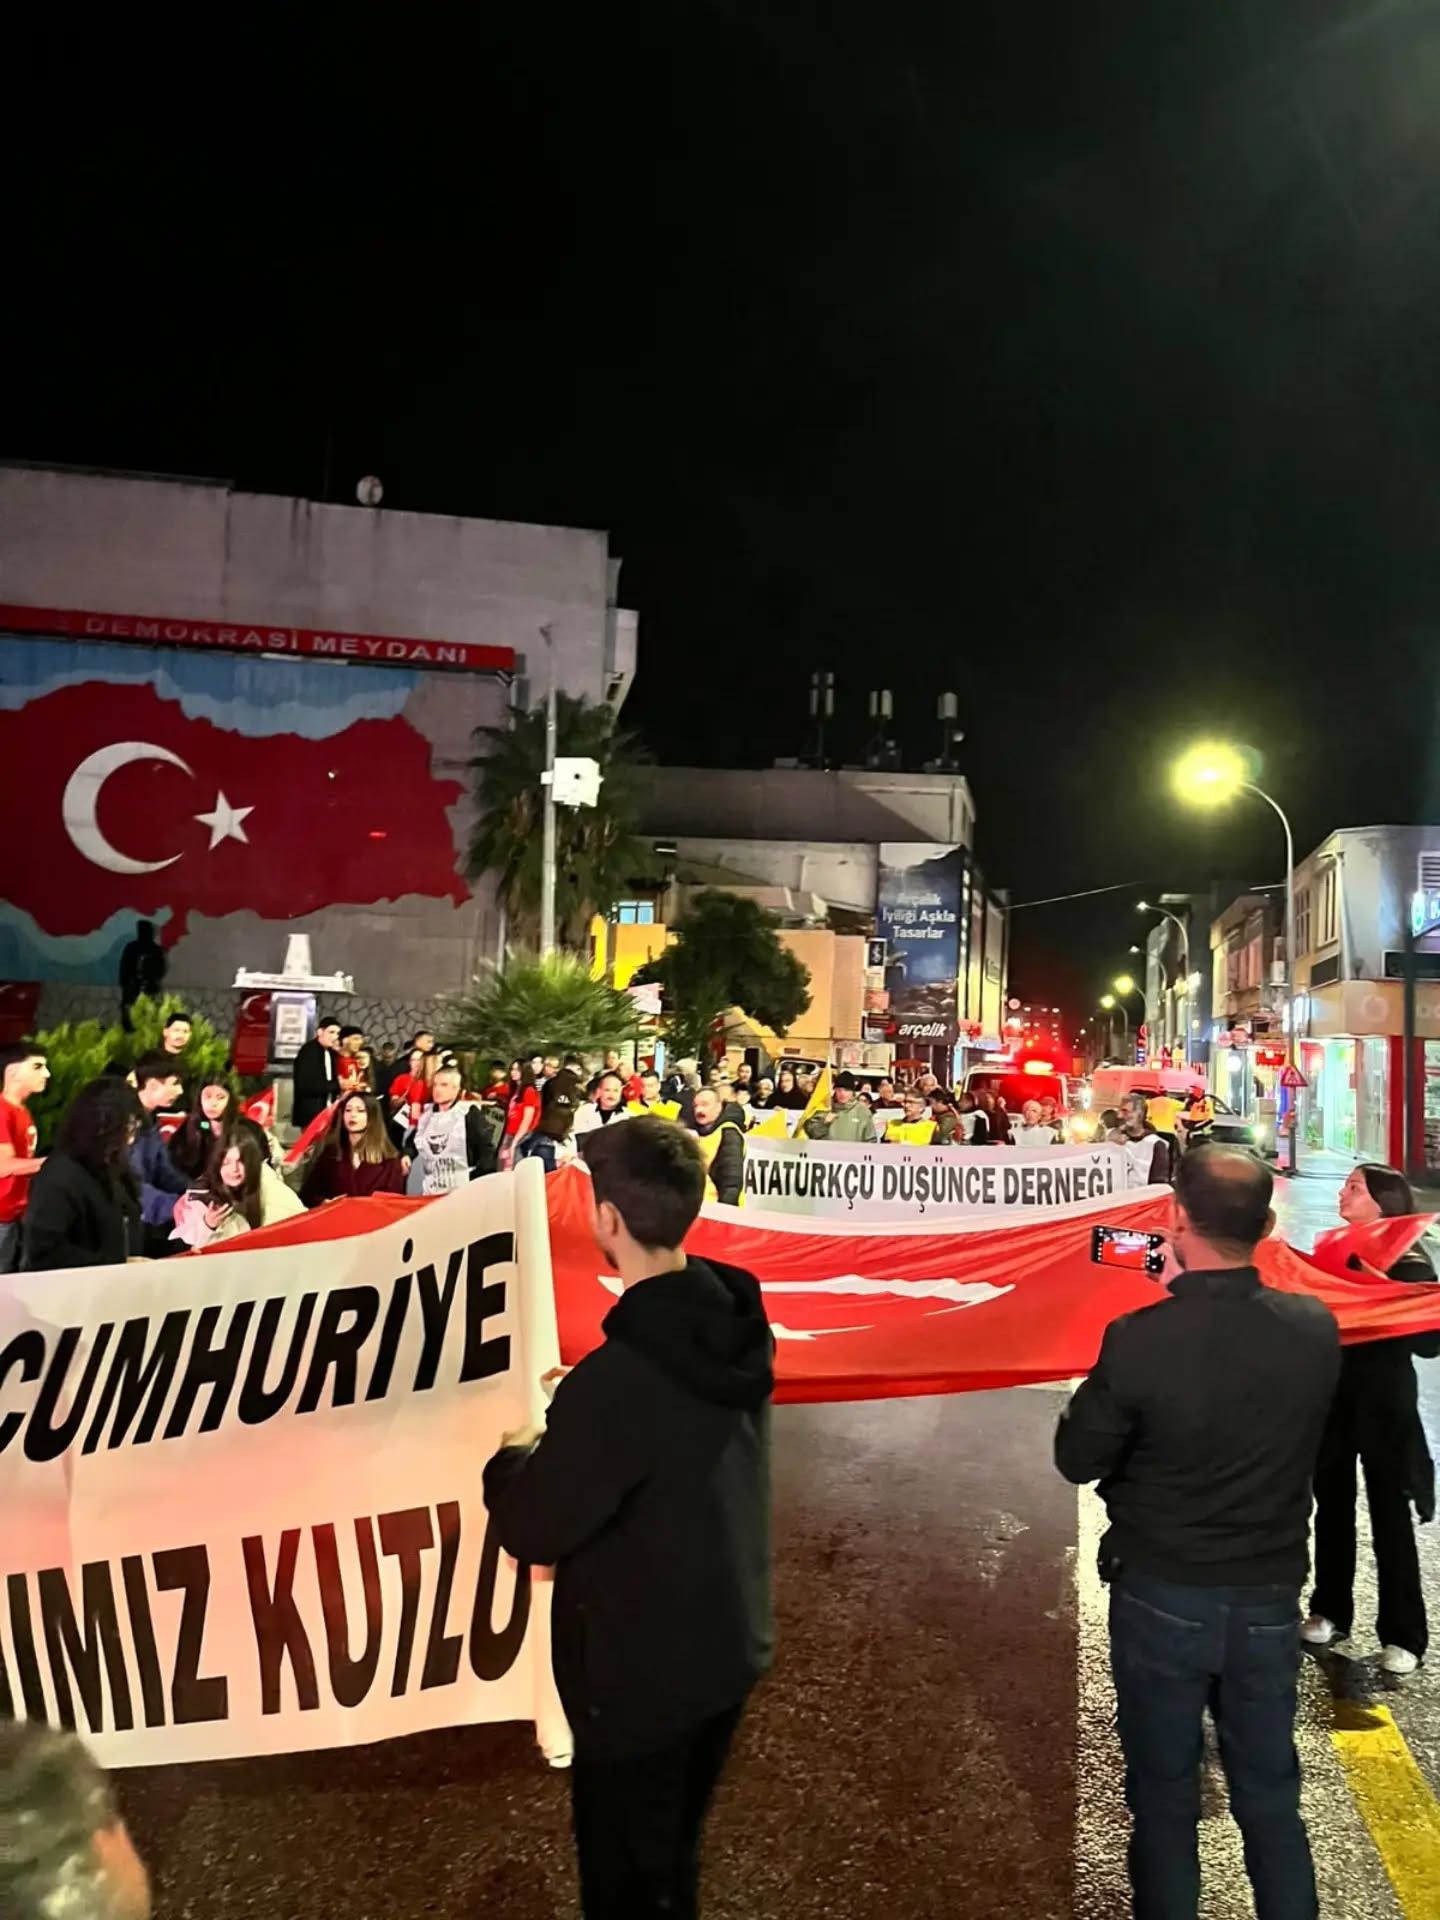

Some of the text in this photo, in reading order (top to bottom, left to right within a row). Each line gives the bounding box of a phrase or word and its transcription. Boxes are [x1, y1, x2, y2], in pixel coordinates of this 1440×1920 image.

[85, 616, 467, 664] DEMOKRASİ MEYDANI
[892, 925, 945, 939] Tasarlar
[919, 909, 956, 925] Aşkla
[898, 1022, 947, 1039] arçelik
[745, 1152, 1113, 1213] ATATÜRKÇÜ DÜŞÜNCE DERNEĞİ
[0, 1231, 518, 1463] CUMHURİYE
[0, 1543, 229, 1734] IMIZ
